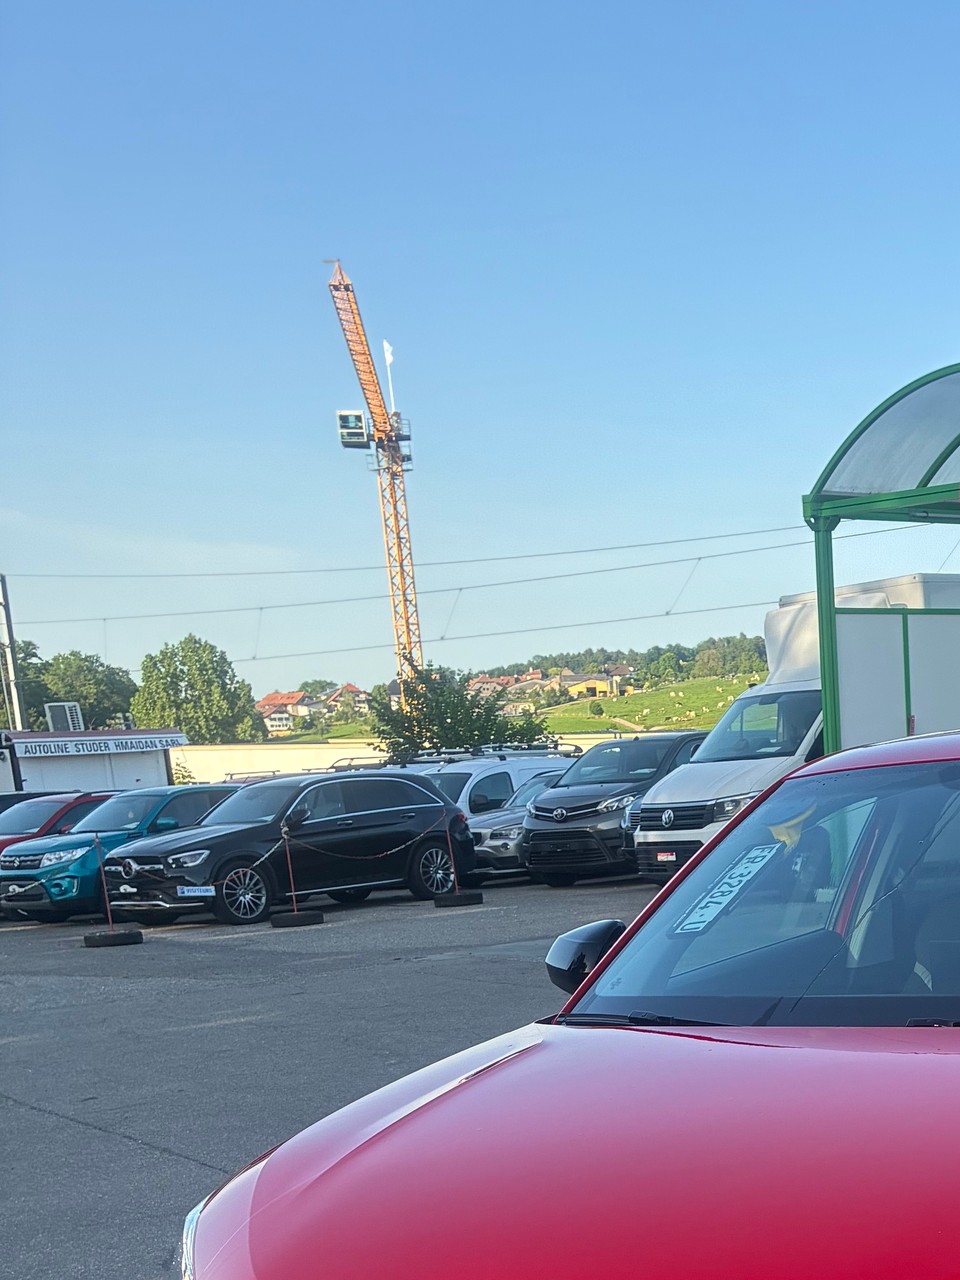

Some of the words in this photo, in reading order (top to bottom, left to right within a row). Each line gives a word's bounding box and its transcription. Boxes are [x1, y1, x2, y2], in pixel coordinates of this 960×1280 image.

[24, 744, 70, 755] AUTOLINE
[75, 742, 111, 753] STUDER
[115, 740, 158, 751] HMAIDAN
[159, 738, 183, 748] SARL
